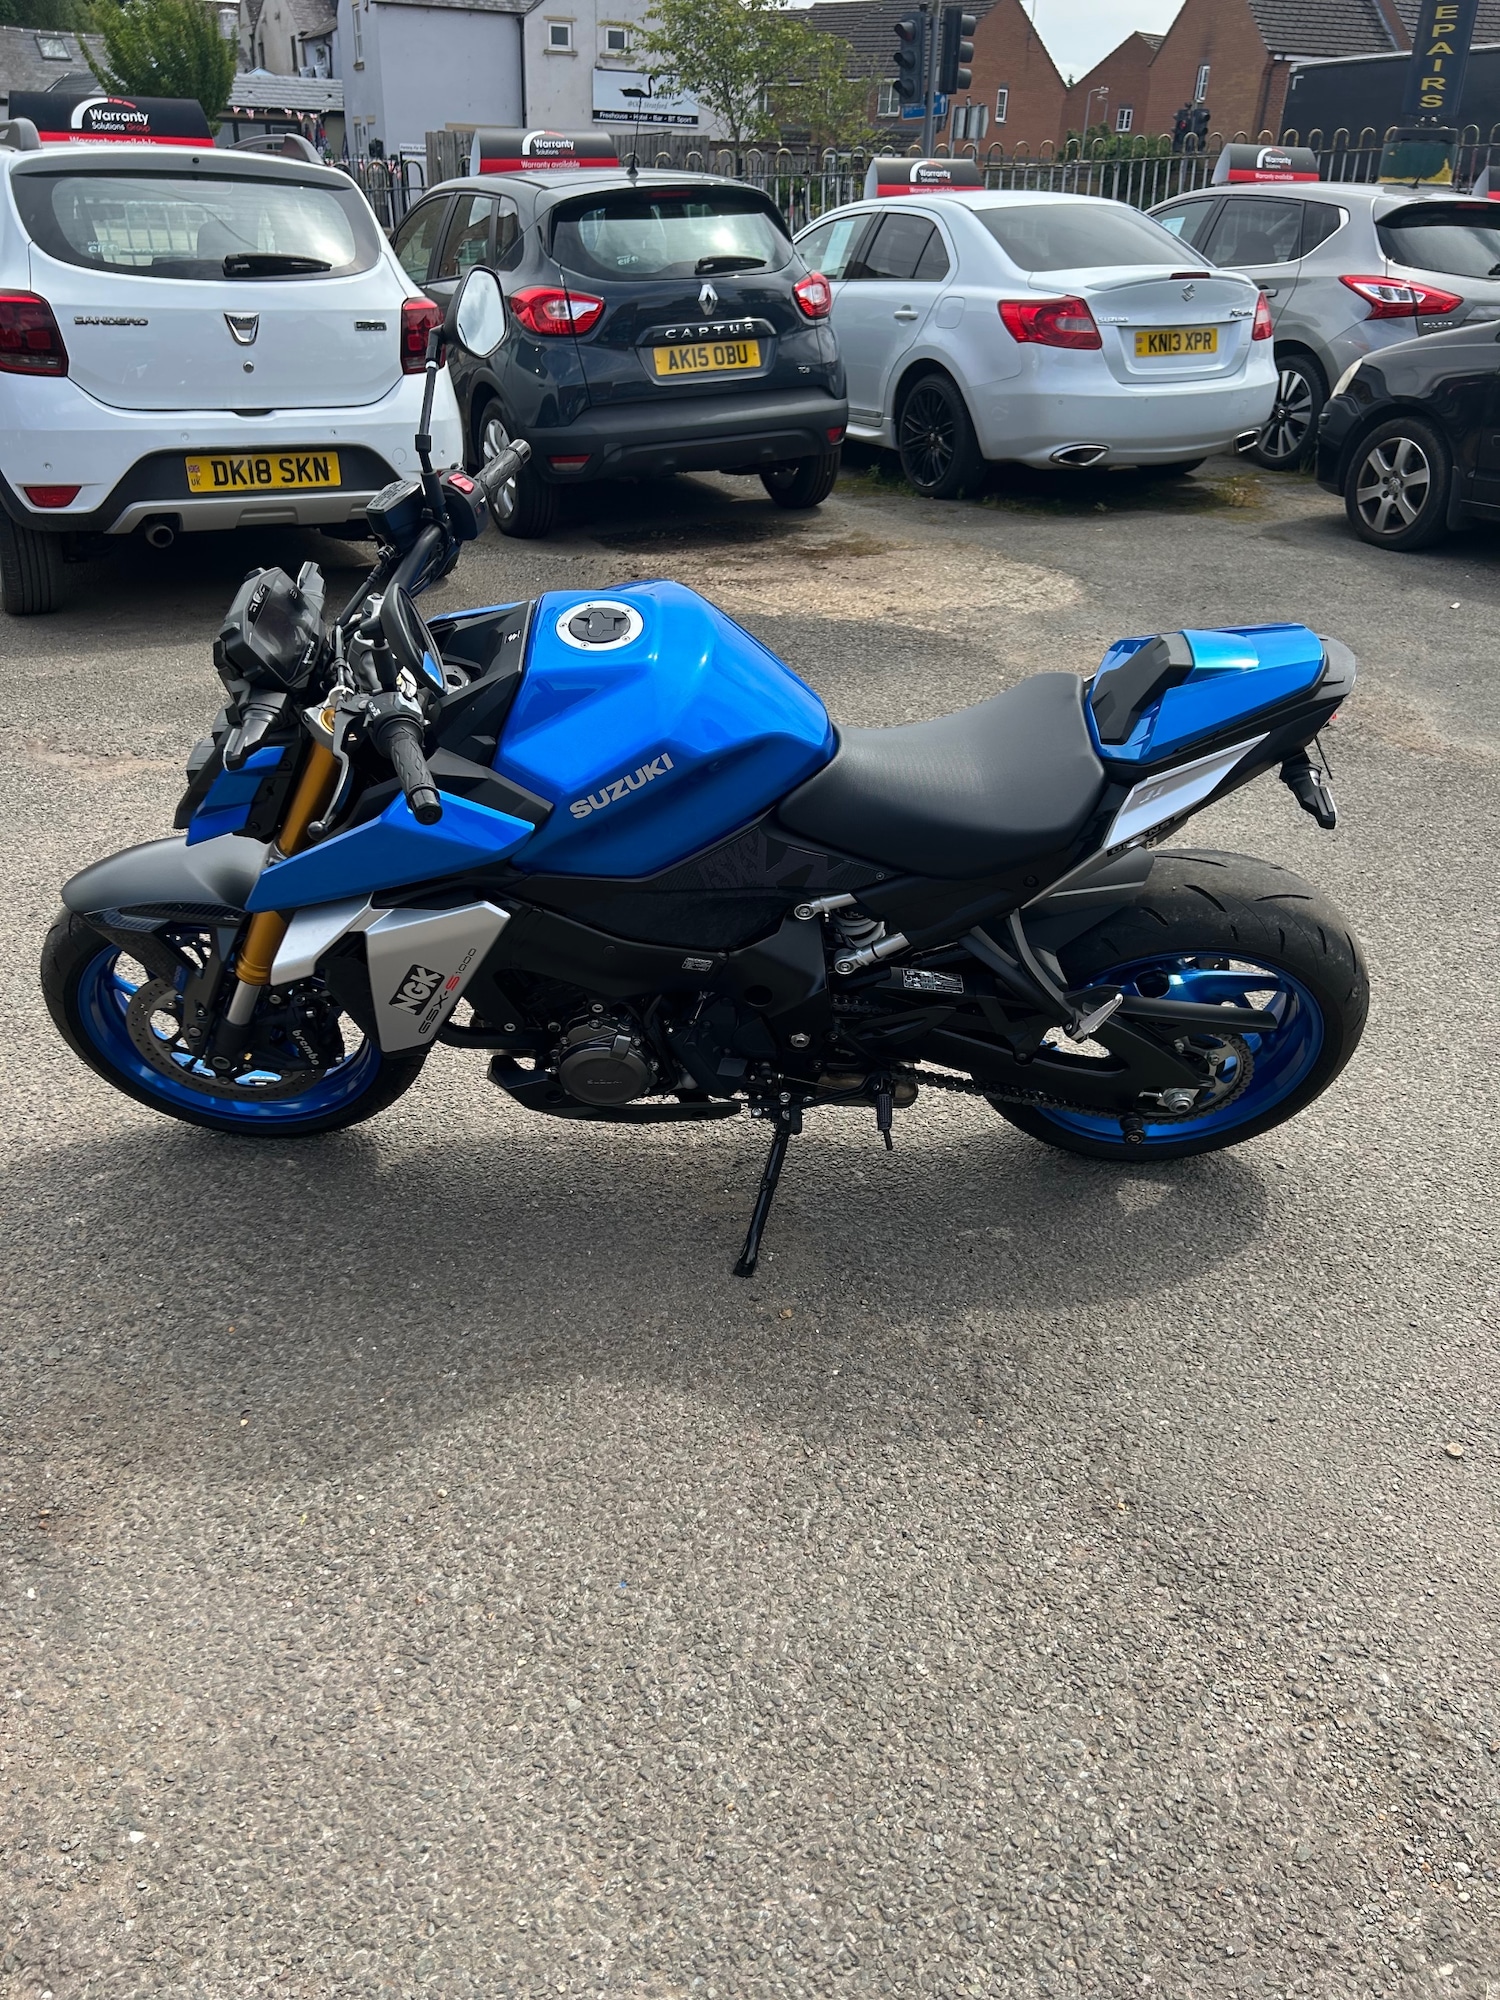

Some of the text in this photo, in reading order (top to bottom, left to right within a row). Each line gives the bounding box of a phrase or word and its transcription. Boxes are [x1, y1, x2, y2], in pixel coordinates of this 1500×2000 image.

[1419, 0, 1459, 108] EPAIRS
[89, 108, 149, 126] Warranty
[91, 121, 151, 133] Solutions Group
[533, 139, 574, 151] Warranty
[521, 160, 580, 170] Warranty available
[1265, 156, 1292, 166] Warranty
[919, 169, 951, 179] Warranty
[665, 323, 754, 338] CAPTUR
[1148, 331, 1212, 353] KN13 XPR
[668, 344, 748, 371] AK15 OBU
[211, 457, 330, 486] DK18 SKN
[569, 752, 674, 819] SUZUKI
[391, 966, 442, 1016] NGK
[292, 1029, 319, 1065] brembo
